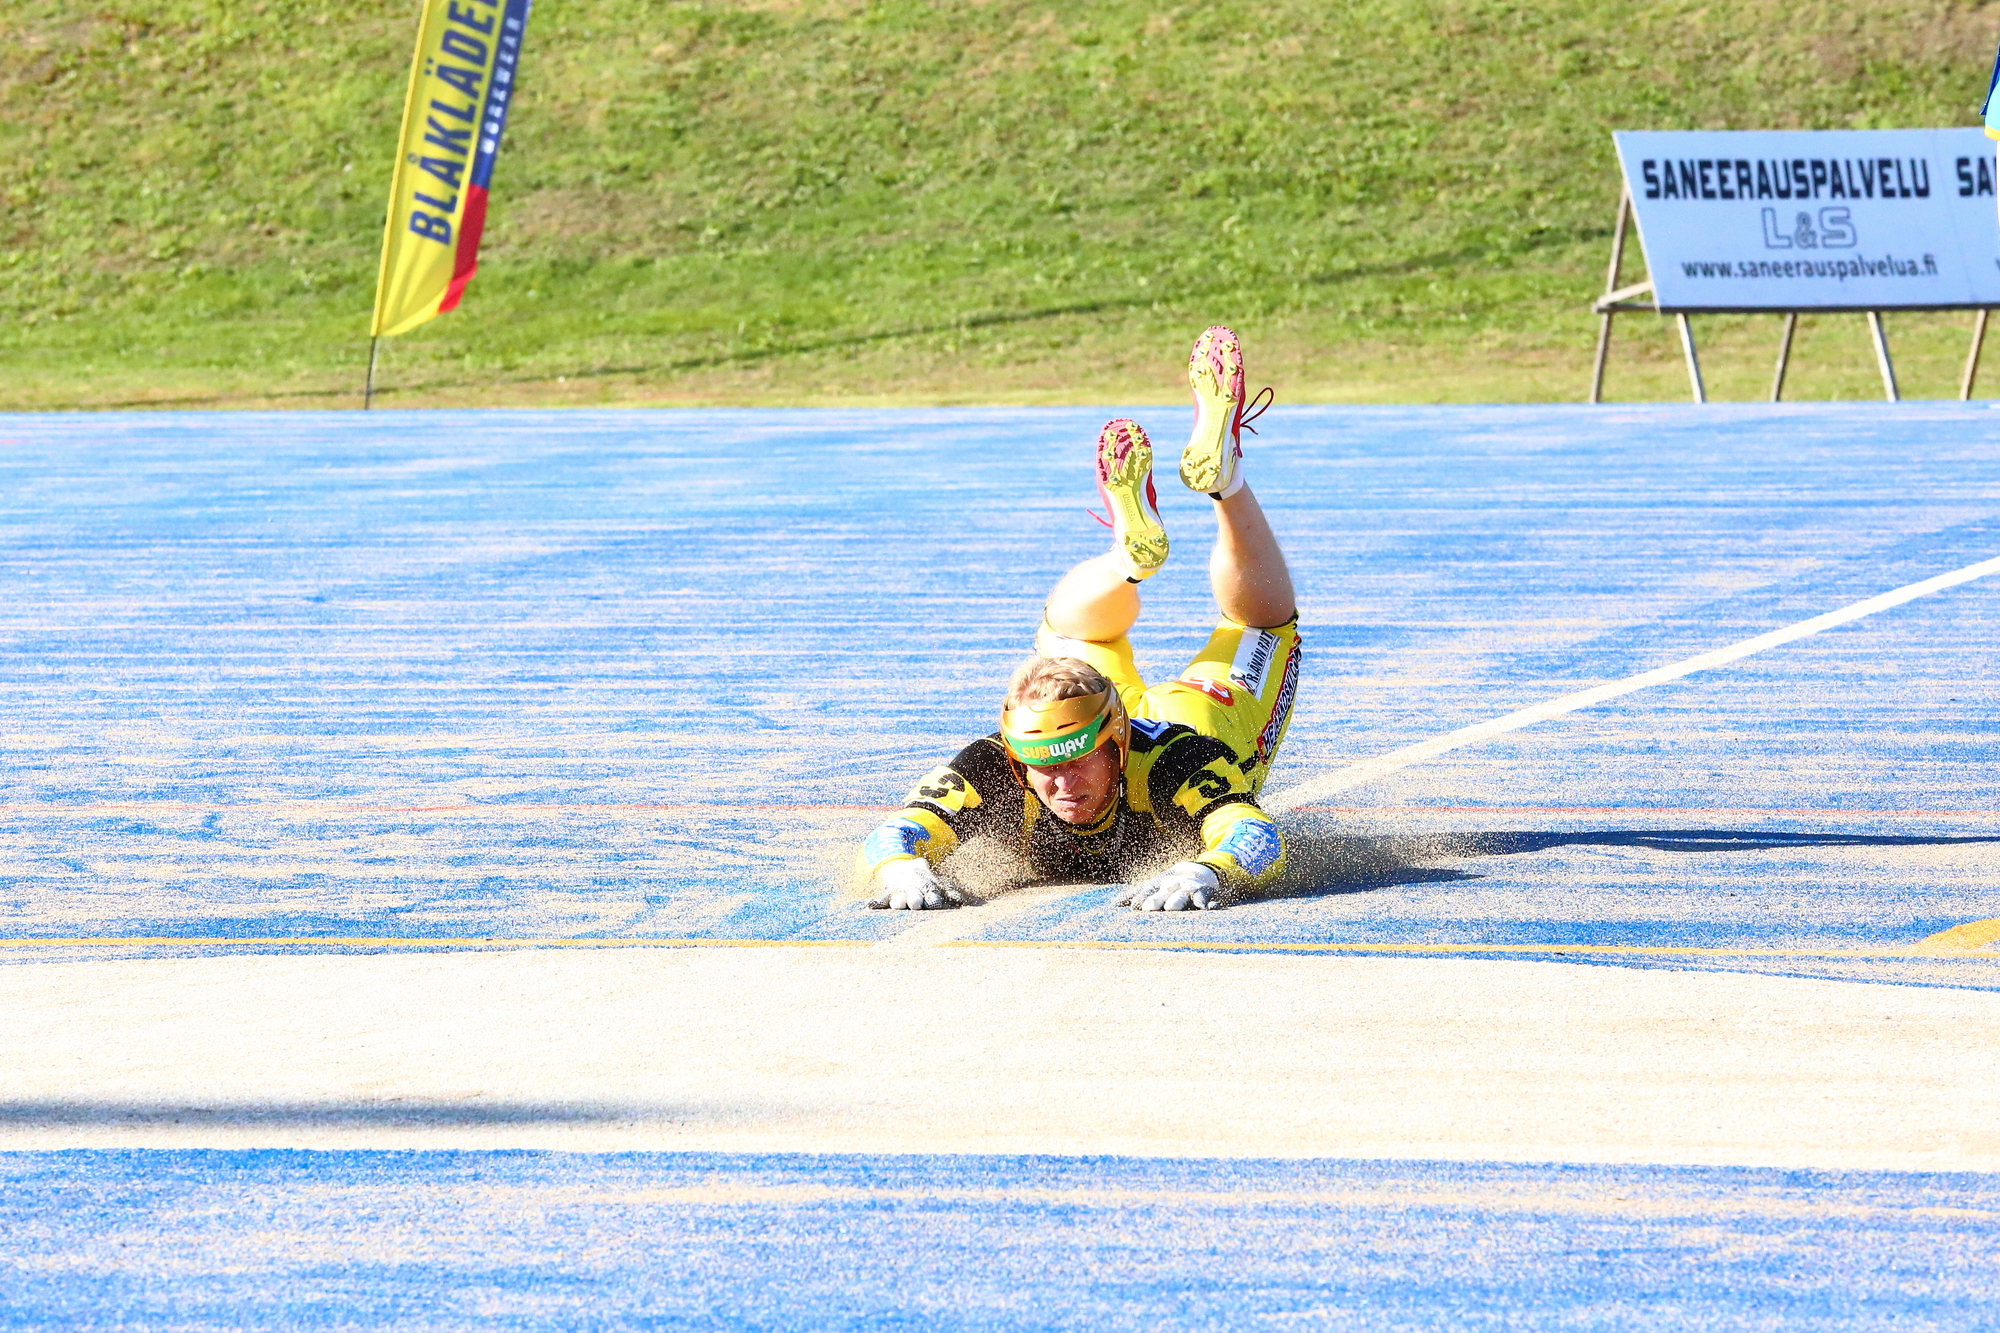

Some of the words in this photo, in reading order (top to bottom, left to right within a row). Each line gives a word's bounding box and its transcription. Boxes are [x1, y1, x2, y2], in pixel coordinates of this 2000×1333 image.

[407, 0, 499, 246] BLÅKLÄDE
[1642, 158, 1931, 200] SANEERAUSPALVELU
[1956, 157, 1997, 197] SA
[1761, 206, 1857, 249] L&S
[1681, 254, 1939, 281] www.saneerauspalvelua.fi
[1021, 733, 1089, 759] SUBWAY
